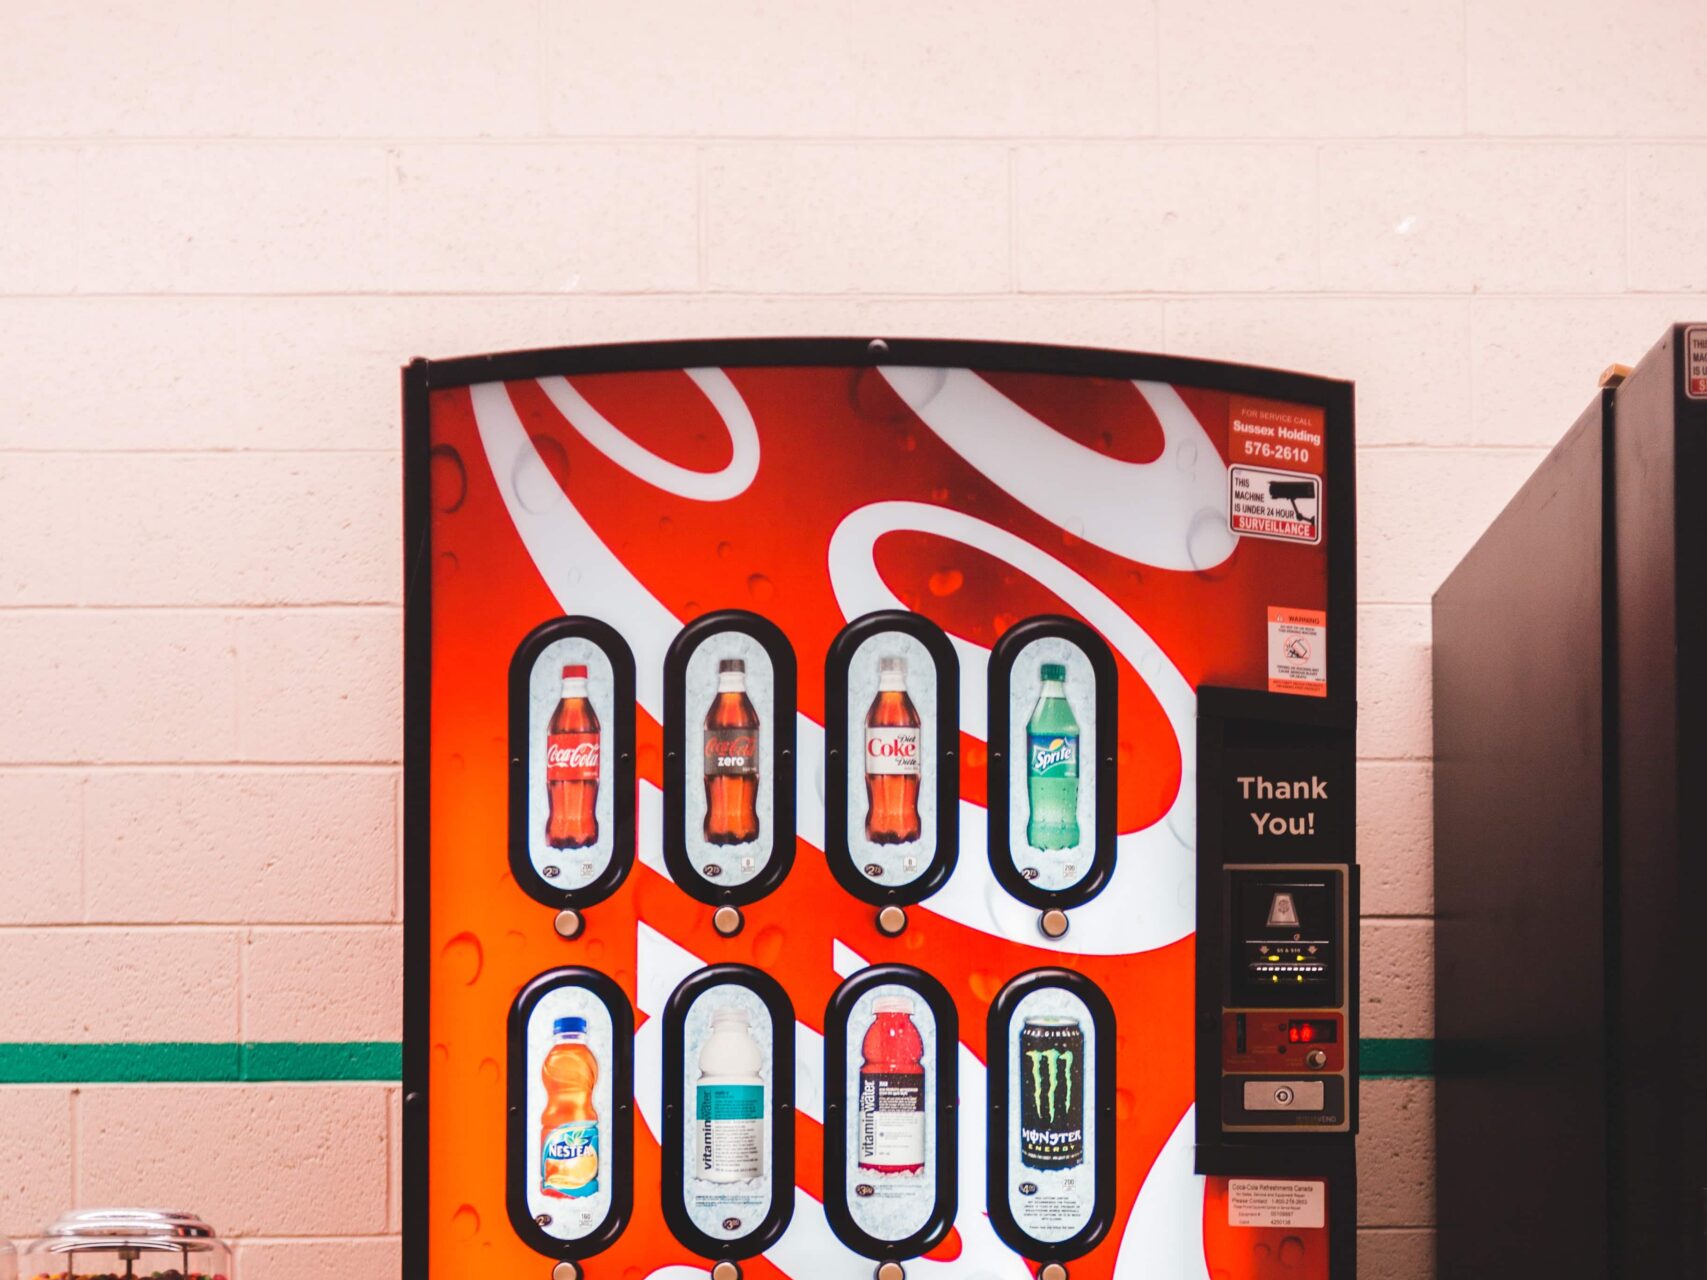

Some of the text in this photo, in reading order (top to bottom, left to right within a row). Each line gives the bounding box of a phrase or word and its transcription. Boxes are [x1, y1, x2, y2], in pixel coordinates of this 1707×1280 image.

[1242, 408, 1312, 426] FOR SERVICE CALL
[1233, 419, 1321, 446] Sussex Holding
[1244, 440, 1309, 463] 576-2610
[1235, 477, 1249, 488] THIS
[1234, 490, 1264, 502] MACHINE
[1234, 503, 1295, 518] IS UNDER 24 HOUR
[1239, 517, 1310, 536] SURVEILLANCE
[547, 743, 599, 768] Coca-Cola
[867, 737, 916, 757] Coke
[717, 756, 745, 767] zero
[1034, 745, 1072, 769] Sprite
[1237, 776, 1328, 799] Thank
[1250, 812, 1315, 835] You!
[1022, 1128, 1081, 1146] MONSTER
